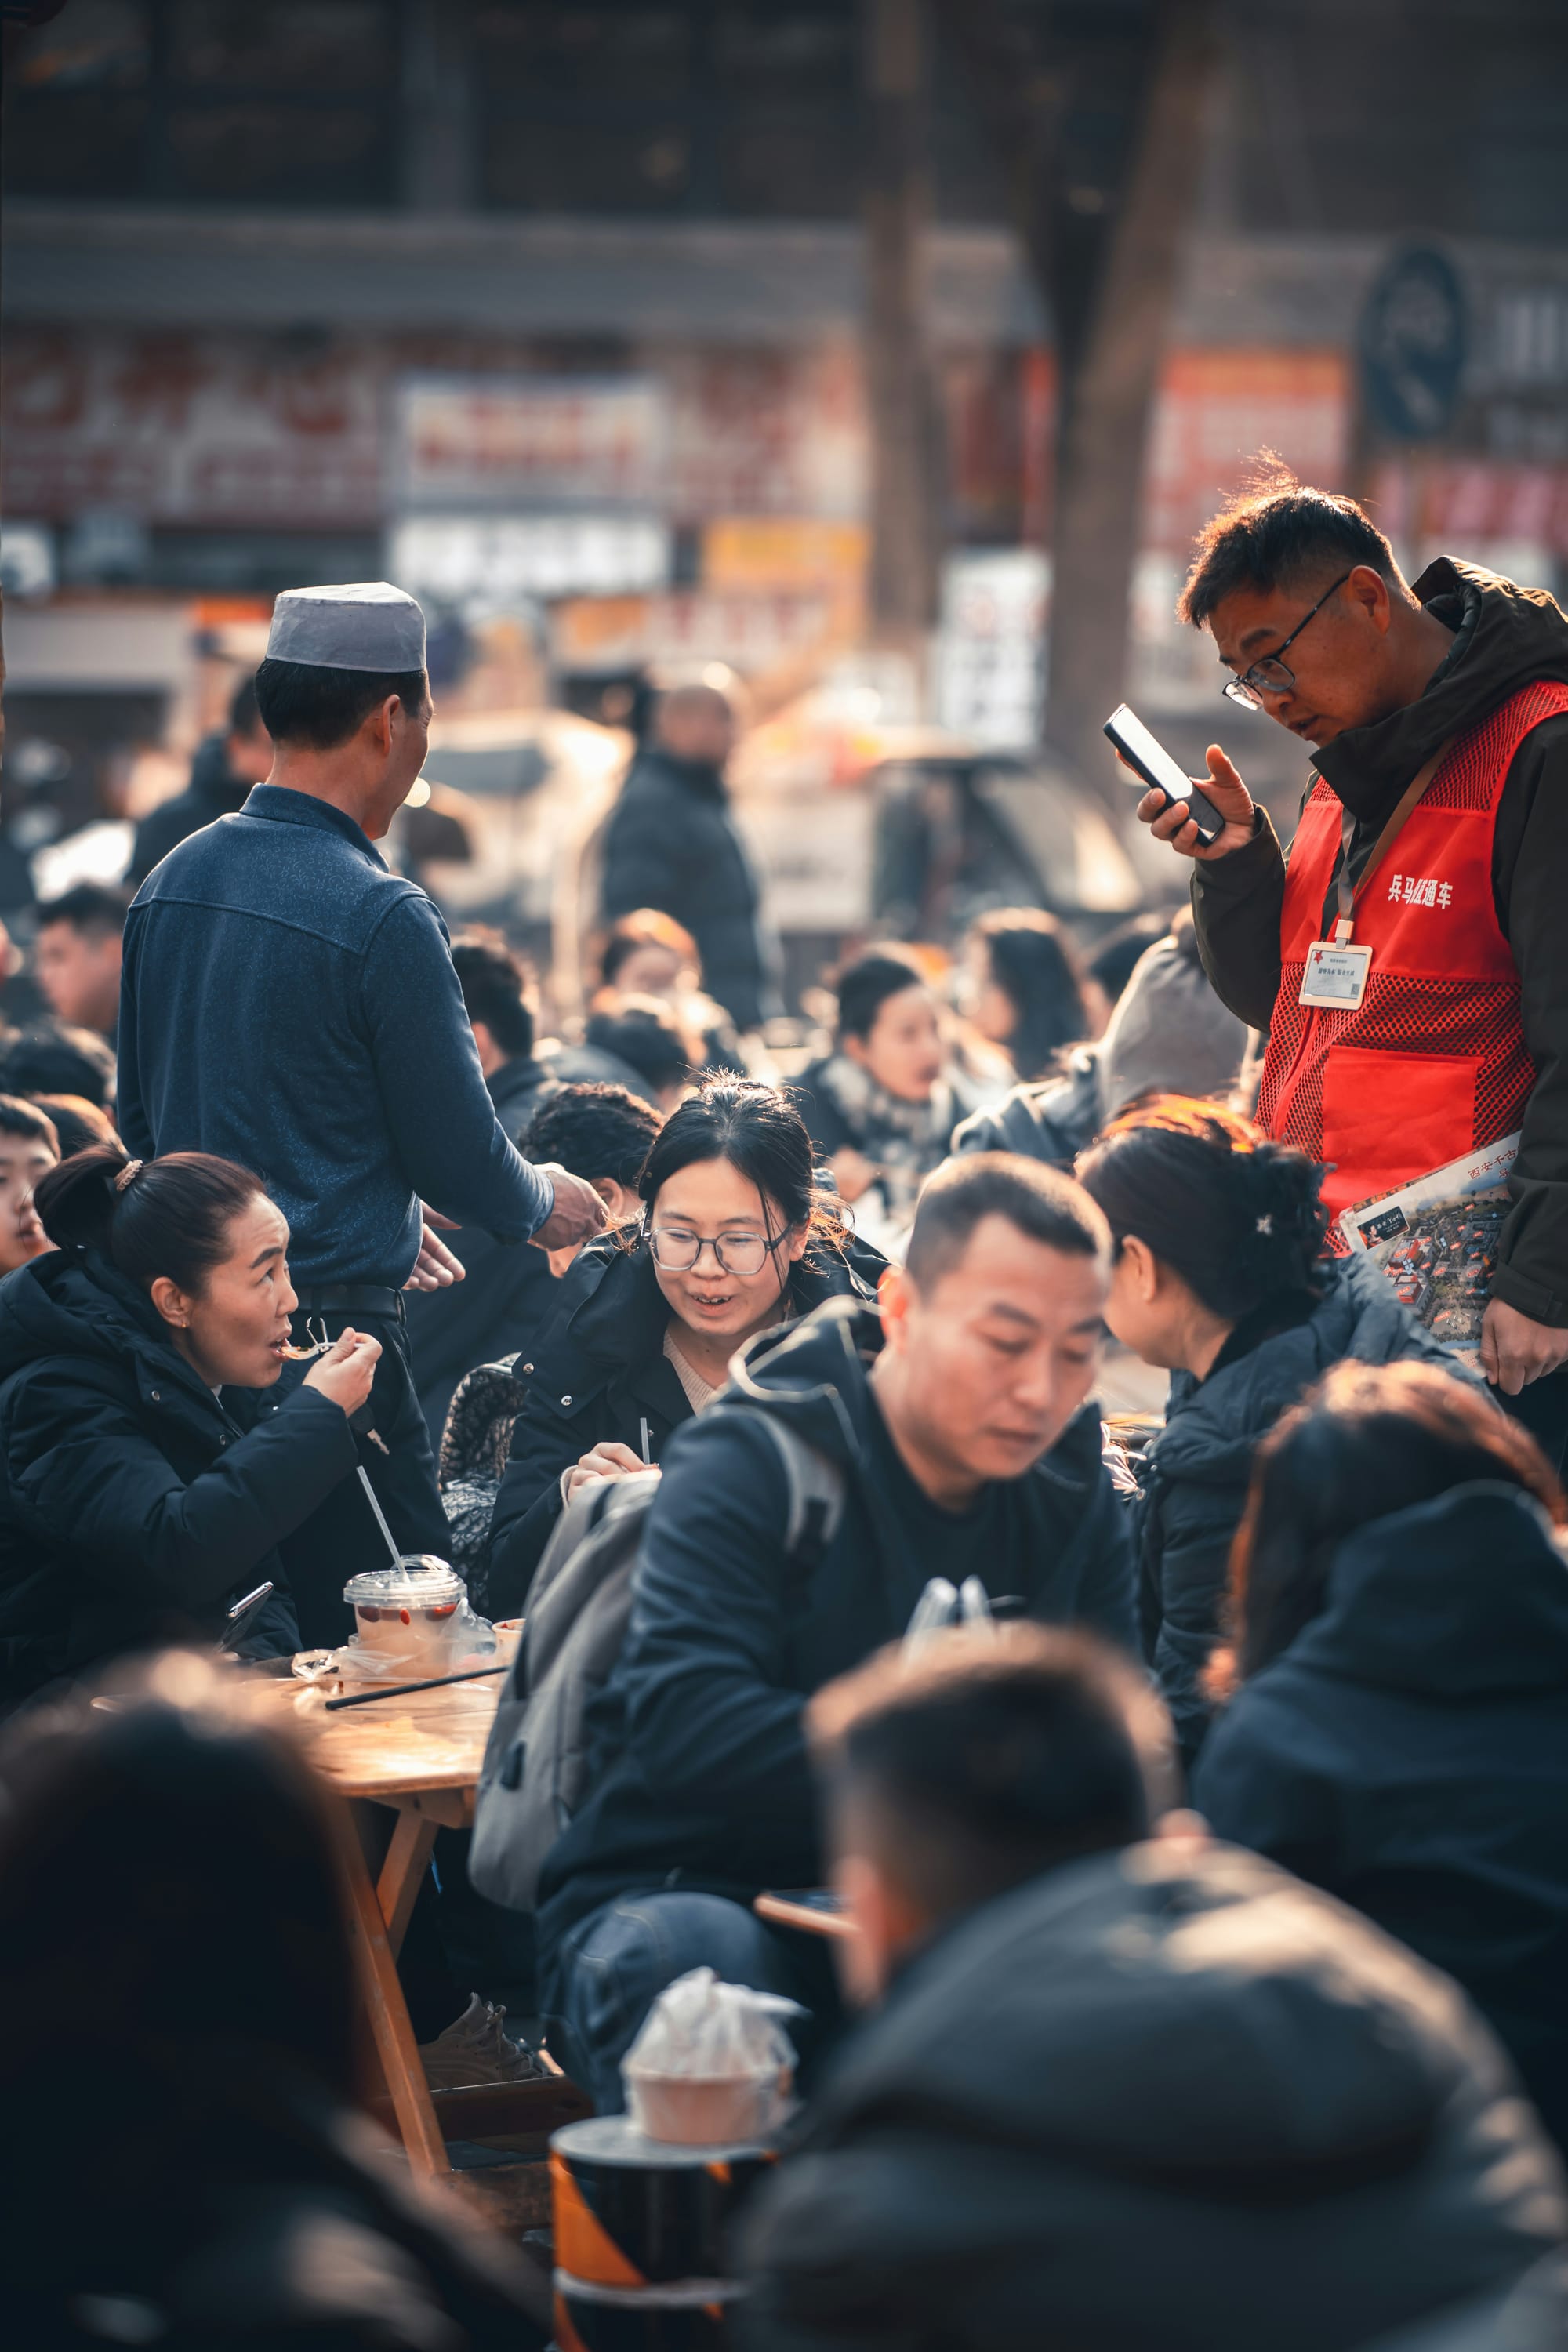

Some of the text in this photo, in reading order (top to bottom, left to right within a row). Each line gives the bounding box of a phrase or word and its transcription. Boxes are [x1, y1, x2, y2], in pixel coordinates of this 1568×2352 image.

[1388, 874, 1453, 909] 兵马直通车
[1468, 1146, 1519, 1179] 西安千古
